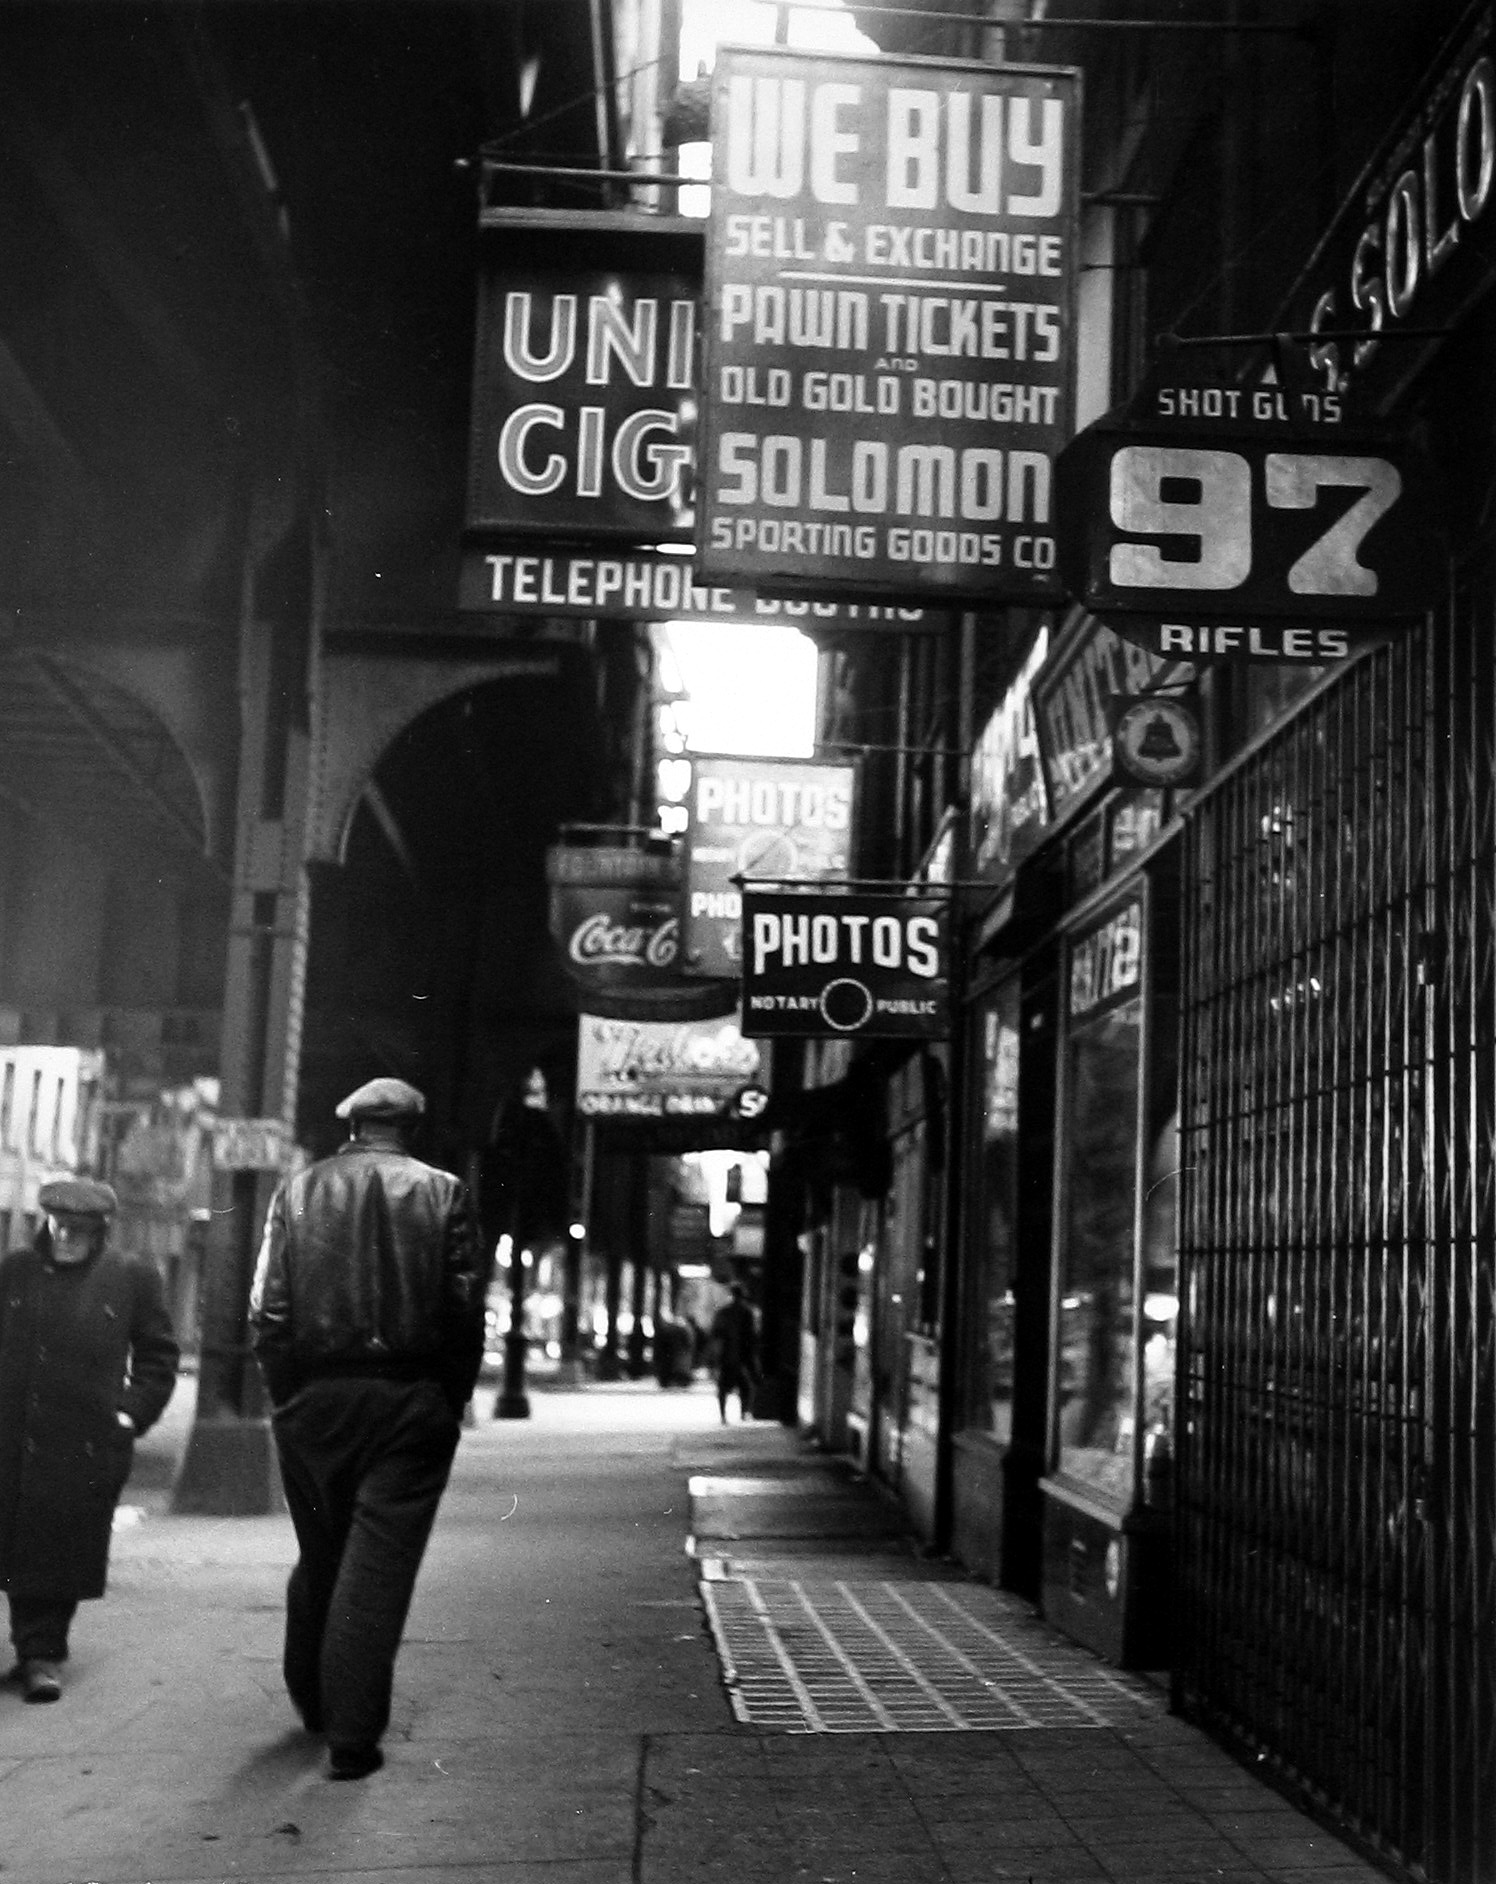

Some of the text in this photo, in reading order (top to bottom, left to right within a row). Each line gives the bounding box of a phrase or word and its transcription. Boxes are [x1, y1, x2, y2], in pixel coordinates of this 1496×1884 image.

[727, 75, 1065, 218] WE BUY
[724, 214, 1063, 277] SELL & EXCHANGE
[720, 283, 1061, 363] PAWN TICKETS
[873, 357, 919, 372] AND
[720, 365, 1060, 425] OLD GOLD BOUGHT
[1158, 388, 1243, 418] SHOT
[718, 431, 1051, 524] SOLOMON
[710, 516, 1056, 569] SPORTING GOODS CO
[1109, 444, 1402, 598] 97
[1160, 622, 1349, 659] RIFLES
[697, 777, 850, 829] PHOTOS
[752, 912, 941, 978] PHOTOS
[750, 995, 937, 1015] NOTARY PUBLIC
